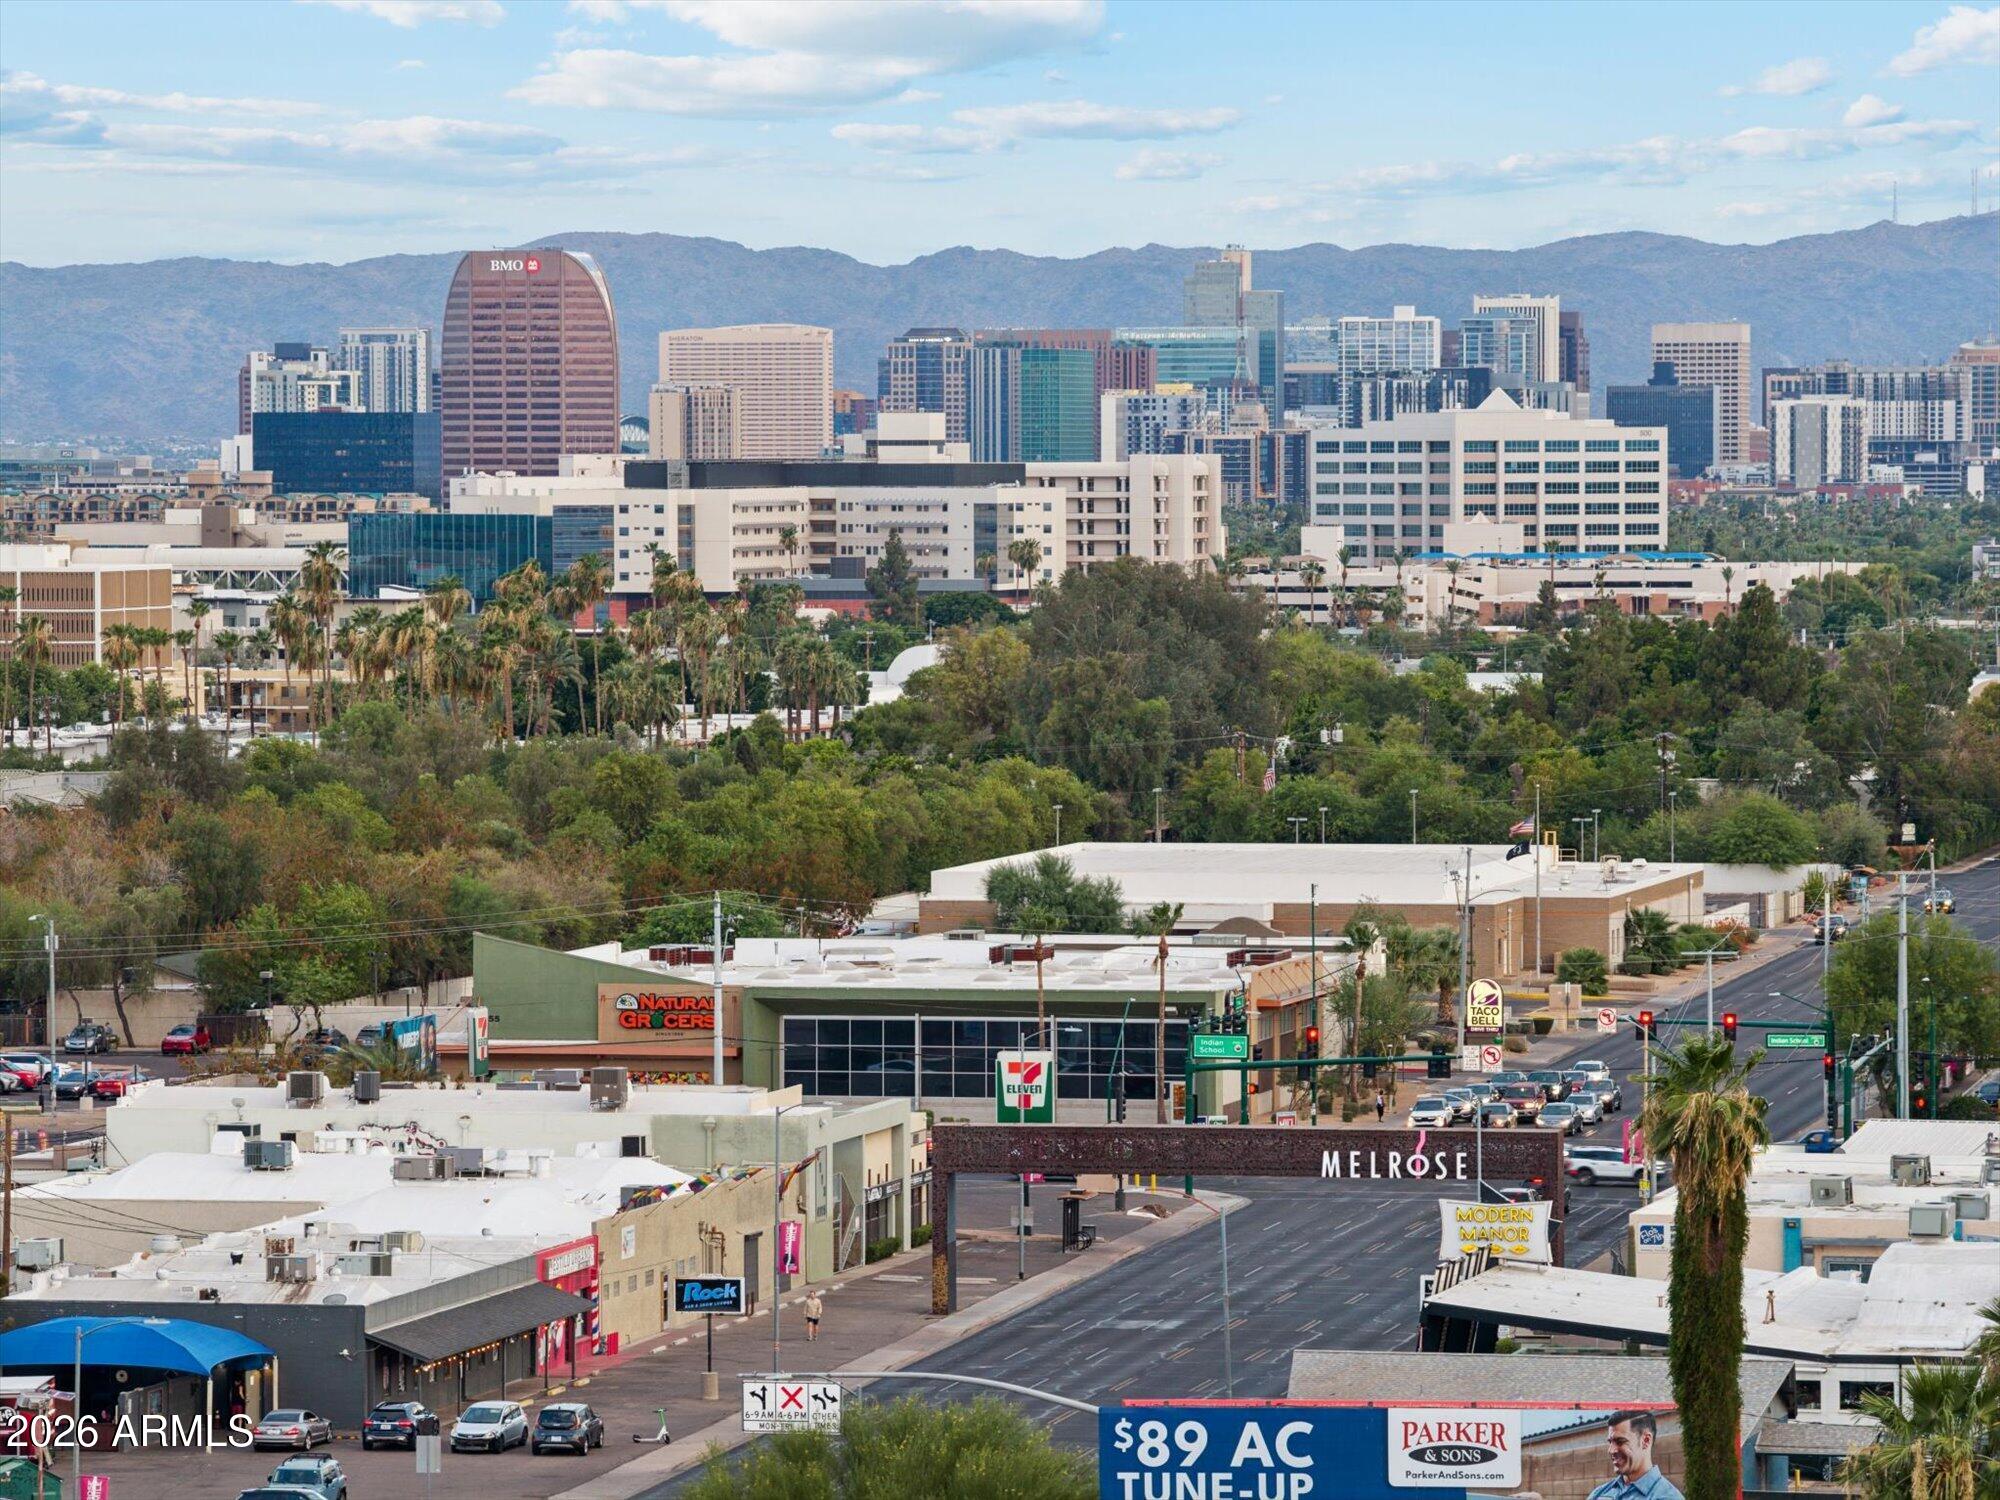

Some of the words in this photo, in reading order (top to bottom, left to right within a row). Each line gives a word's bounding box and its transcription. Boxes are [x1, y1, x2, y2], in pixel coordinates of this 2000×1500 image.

[490, 259, 524, 271] BMO
[1470, 1006, 1500, 1016] TACO
[618, 1010, 715, 1030] GROCERS
[1471, 1016, 1499, 1026] BELL
[1321, 1150, 1468, 1180] MELROSE
[1455, 1206, 1534, 1223] MODERN
[1460, 1226, 1530, 1242] MANOR
[683, 1282, 738, 1302] Rock
[745, 1411, 759, 1419] 6-9
[761, 1411, 774, 1419] AM
[777, 1411, 792, 1419] 4-6
[1113, 1417, 1208, 1468] $89
[1230, 1421, 1315, 1468] AC
[1402, 1421, 1508, 1451] PARKER
[1424, 1448, 1437, 1462] &
[1441, 1449, 1482, 1462] SONS
[1405, 1470, 1505, 1480] ParkerAndSons.com
[1117, 1472, 1314, 1500] TUNE-UP
